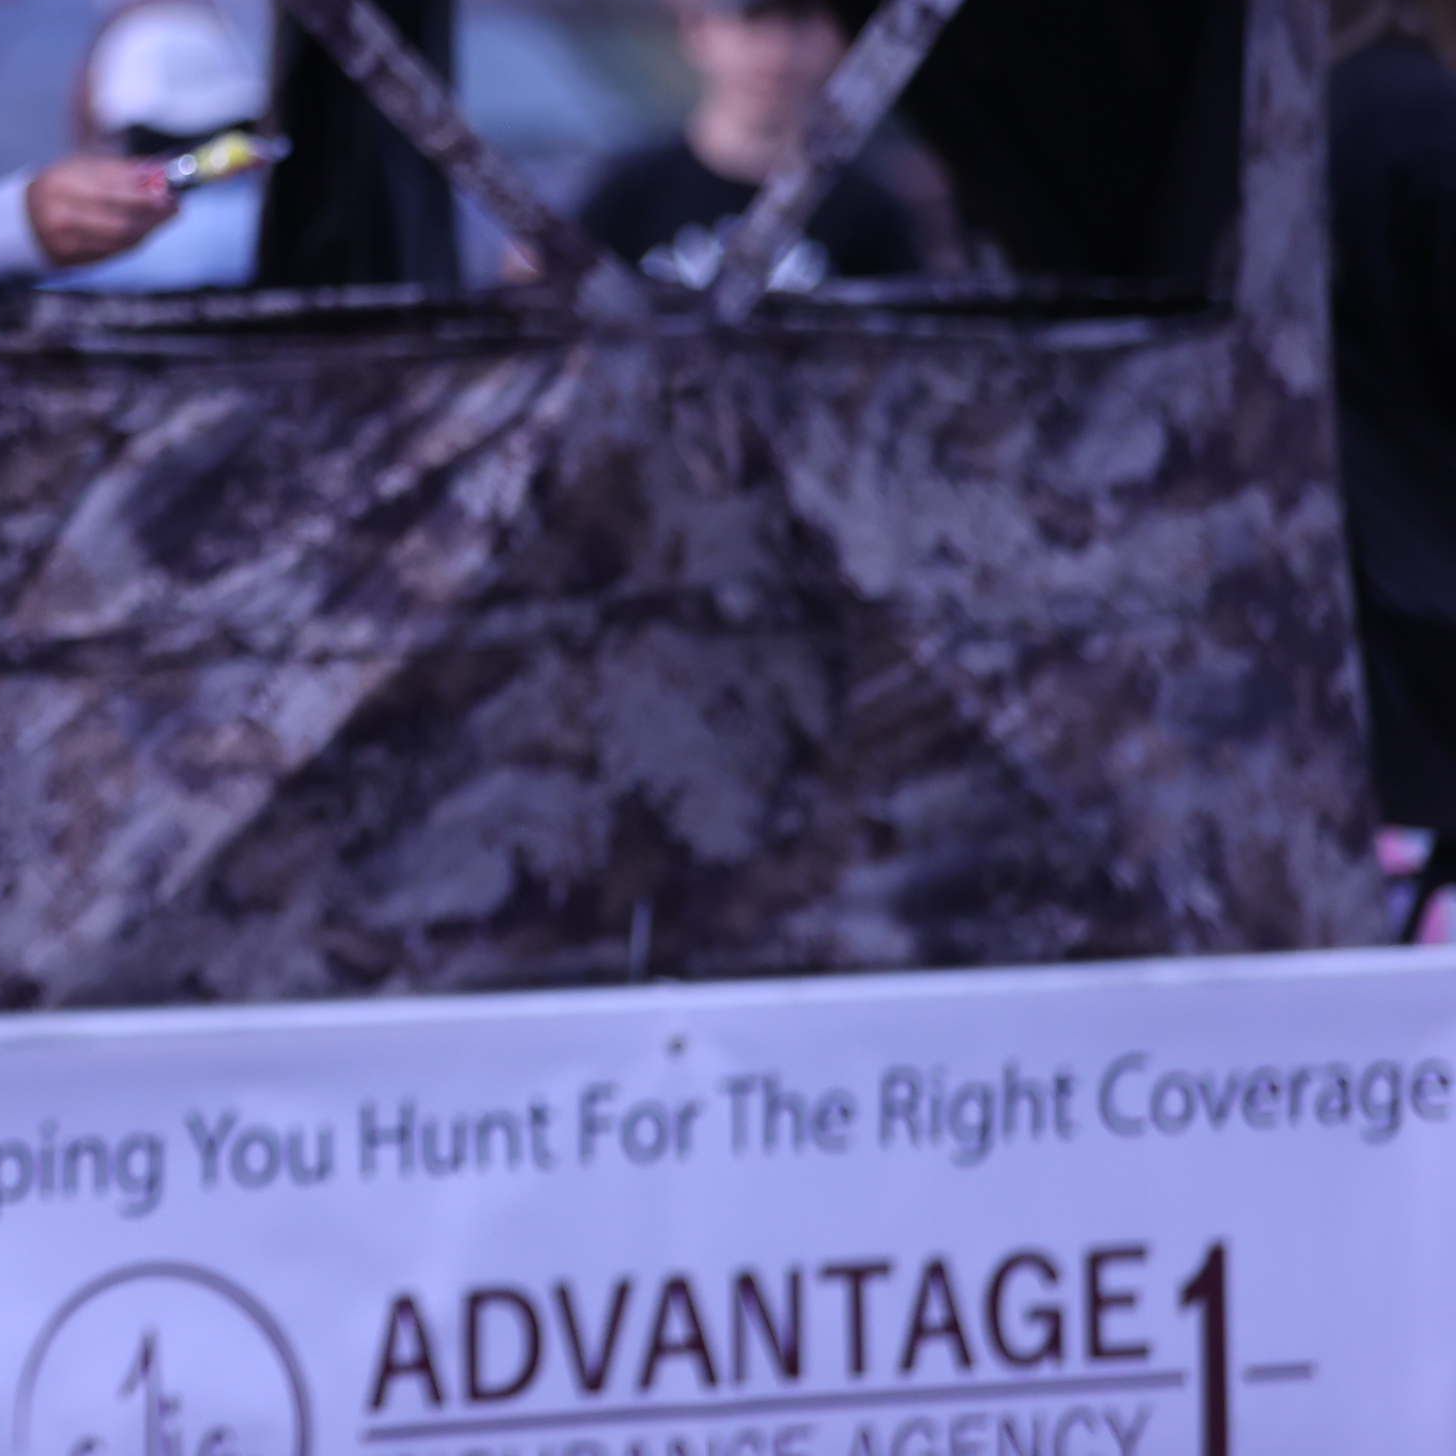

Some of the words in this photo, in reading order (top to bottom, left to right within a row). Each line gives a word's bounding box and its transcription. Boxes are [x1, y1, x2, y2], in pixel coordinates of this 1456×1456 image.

[184, 1103, 335, 1192] You
[357, 1094, 558, 1182] Hunt
[577, 1080, 704, 1166] For
[715, 1068, 856, 1157] The
[878, 1054, 1076, 1169] Right
[1096, 1049, 1454, 1145] Coverage
[367, 1240, 1151, 1413] ADVANTAGE
